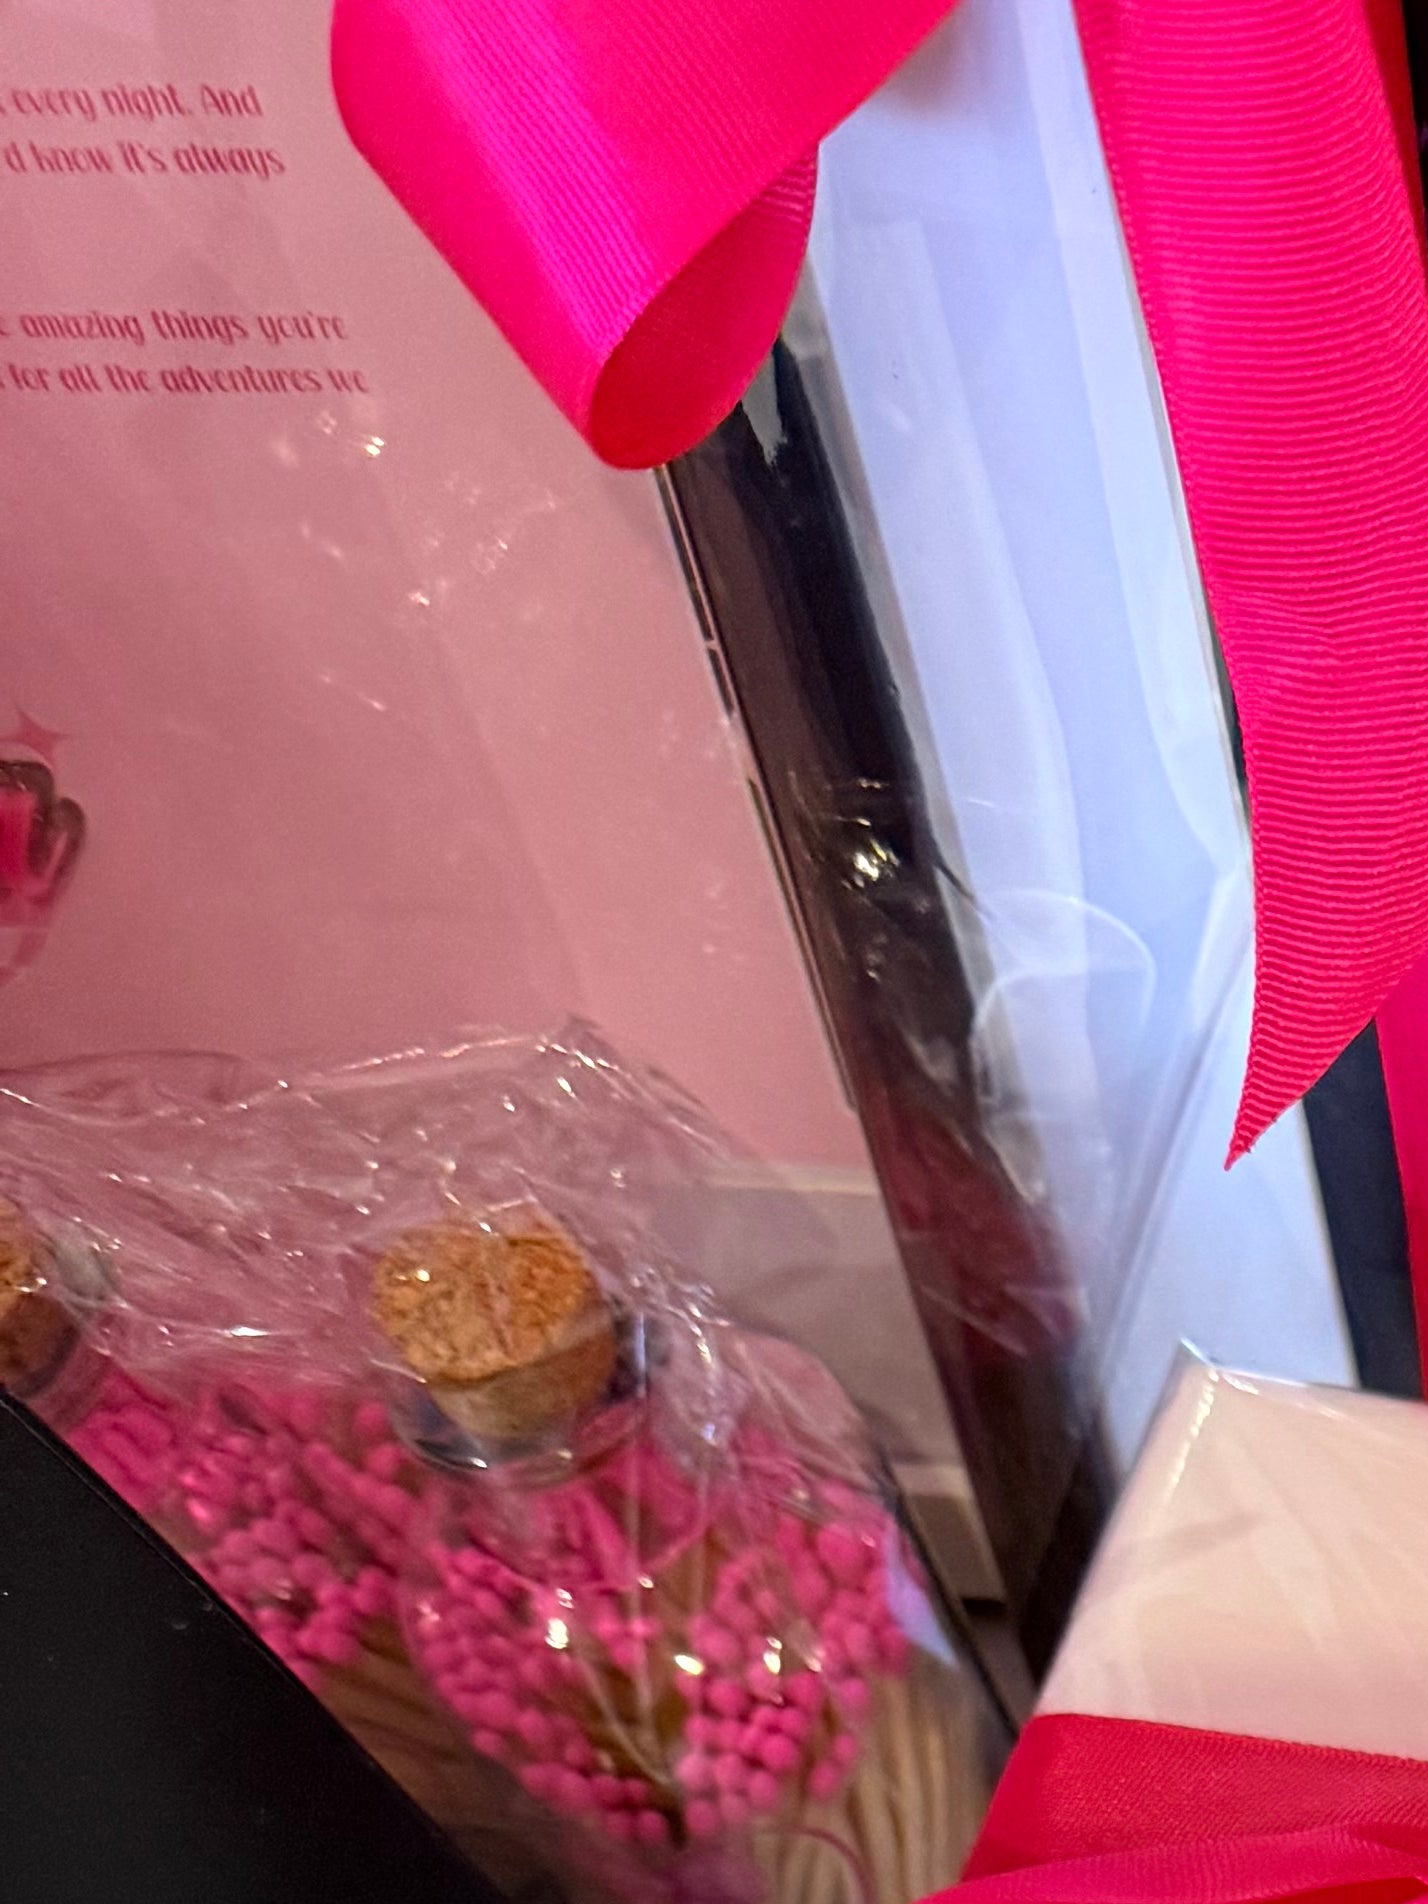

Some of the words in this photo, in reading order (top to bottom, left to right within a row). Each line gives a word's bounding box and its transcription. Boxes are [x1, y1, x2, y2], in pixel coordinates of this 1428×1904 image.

[12, 88, 97, 122] every
[199, 84, 263, 117] And
[29, 139, 112, 174] know
[172, 142, 286, 180] always
[19, 310, 146, 346] amazing
[151, 310, 249, 345] things
[257, 311, 347, 345] you're
[59, 362, 103, 393] all
[103, 362, 151, 393] the
[160, 363, 323, 394] adventures
[325, 367, 369, 394] we
